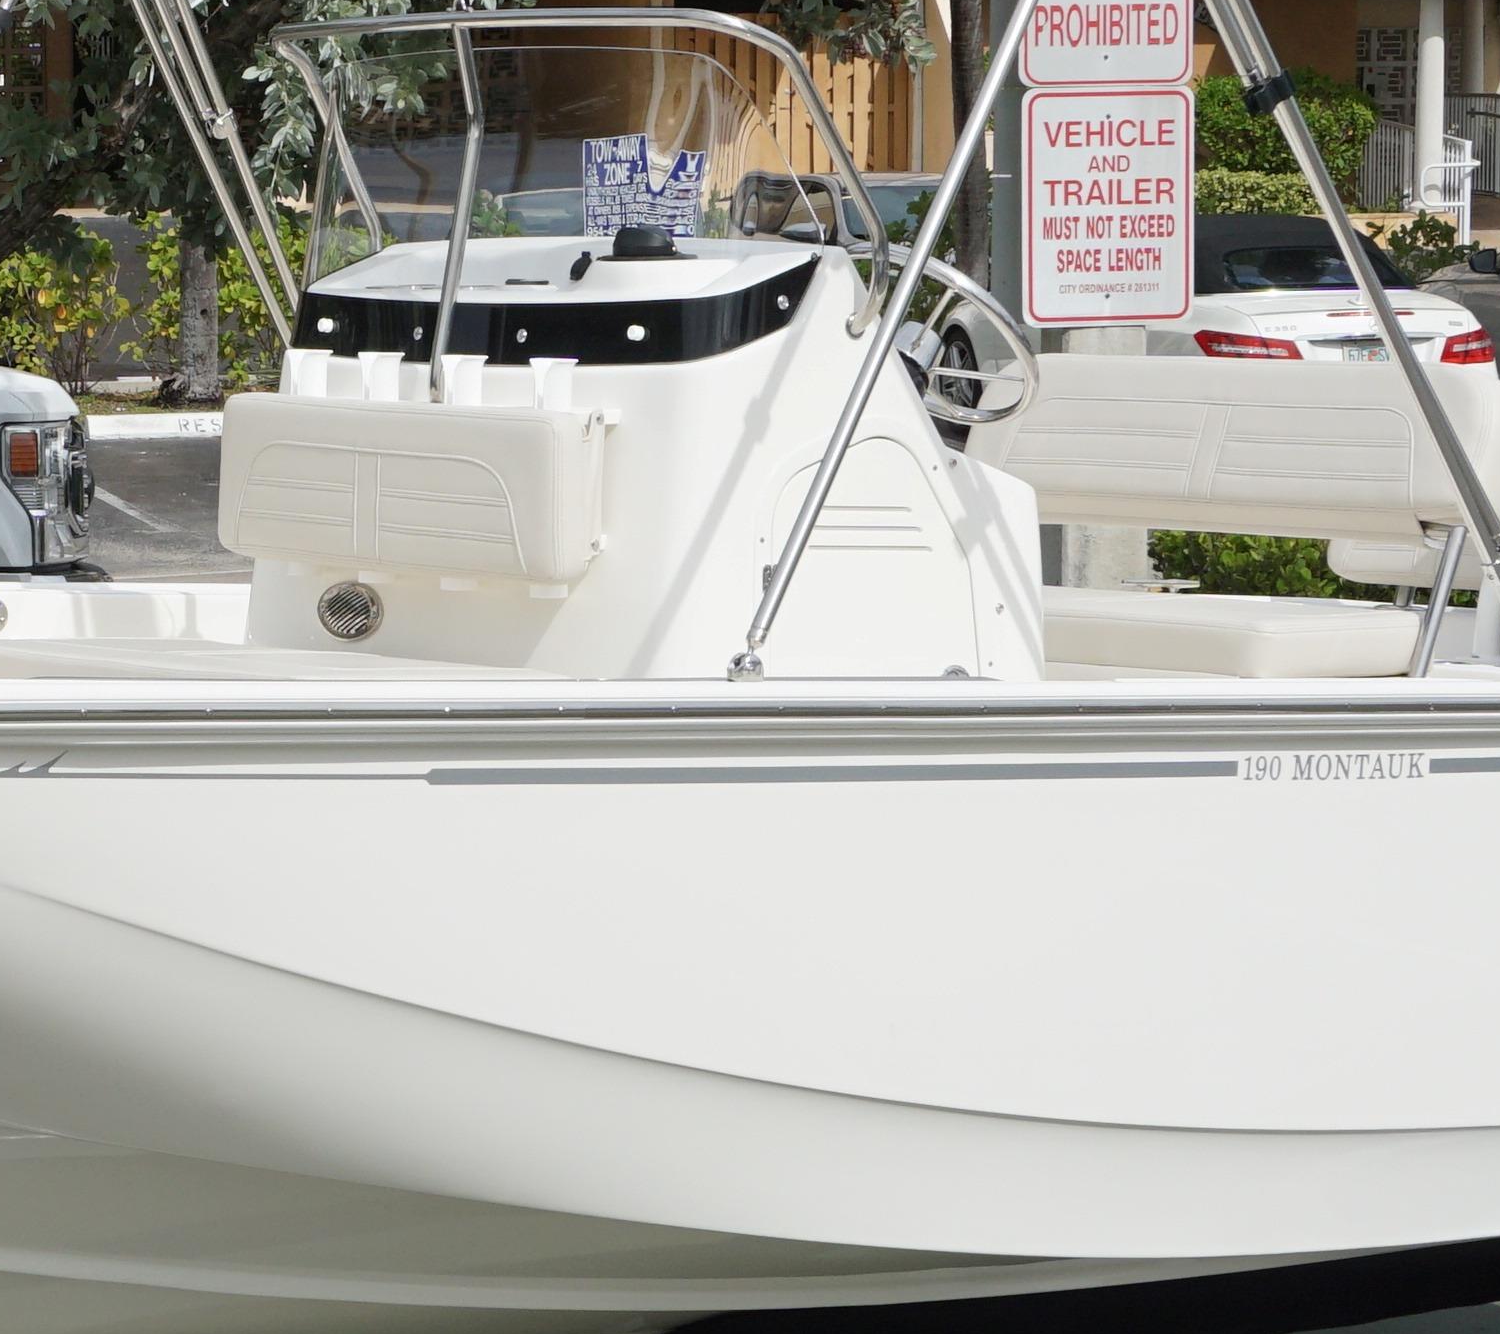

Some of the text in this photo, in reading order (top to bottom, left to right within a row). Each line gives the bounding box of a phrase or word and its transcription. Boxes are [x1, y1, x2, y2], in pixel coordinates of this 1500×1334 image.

[1035, 3, 1178, 47] PROHIBITED
[1043, 119, 1176, 148] VEHICLE
[590, 136, 640, 163] TOW-AWAY
[604, 163, 631, 185] ZONE
[1088, 155, 1130, 173] AND
[1043, 178, 1175, 206] TRAILER
[1043, 214, 1175, 240] MUST NOT EXCEED
[1057, 247, 1161, 273] SPACE LENGTH
[1059, 284, 1077, 294] CITY
[1079, 283, 1125, 294] ORDINANCE
[1243, 753, 1425, 781] 190 MONTAUK
